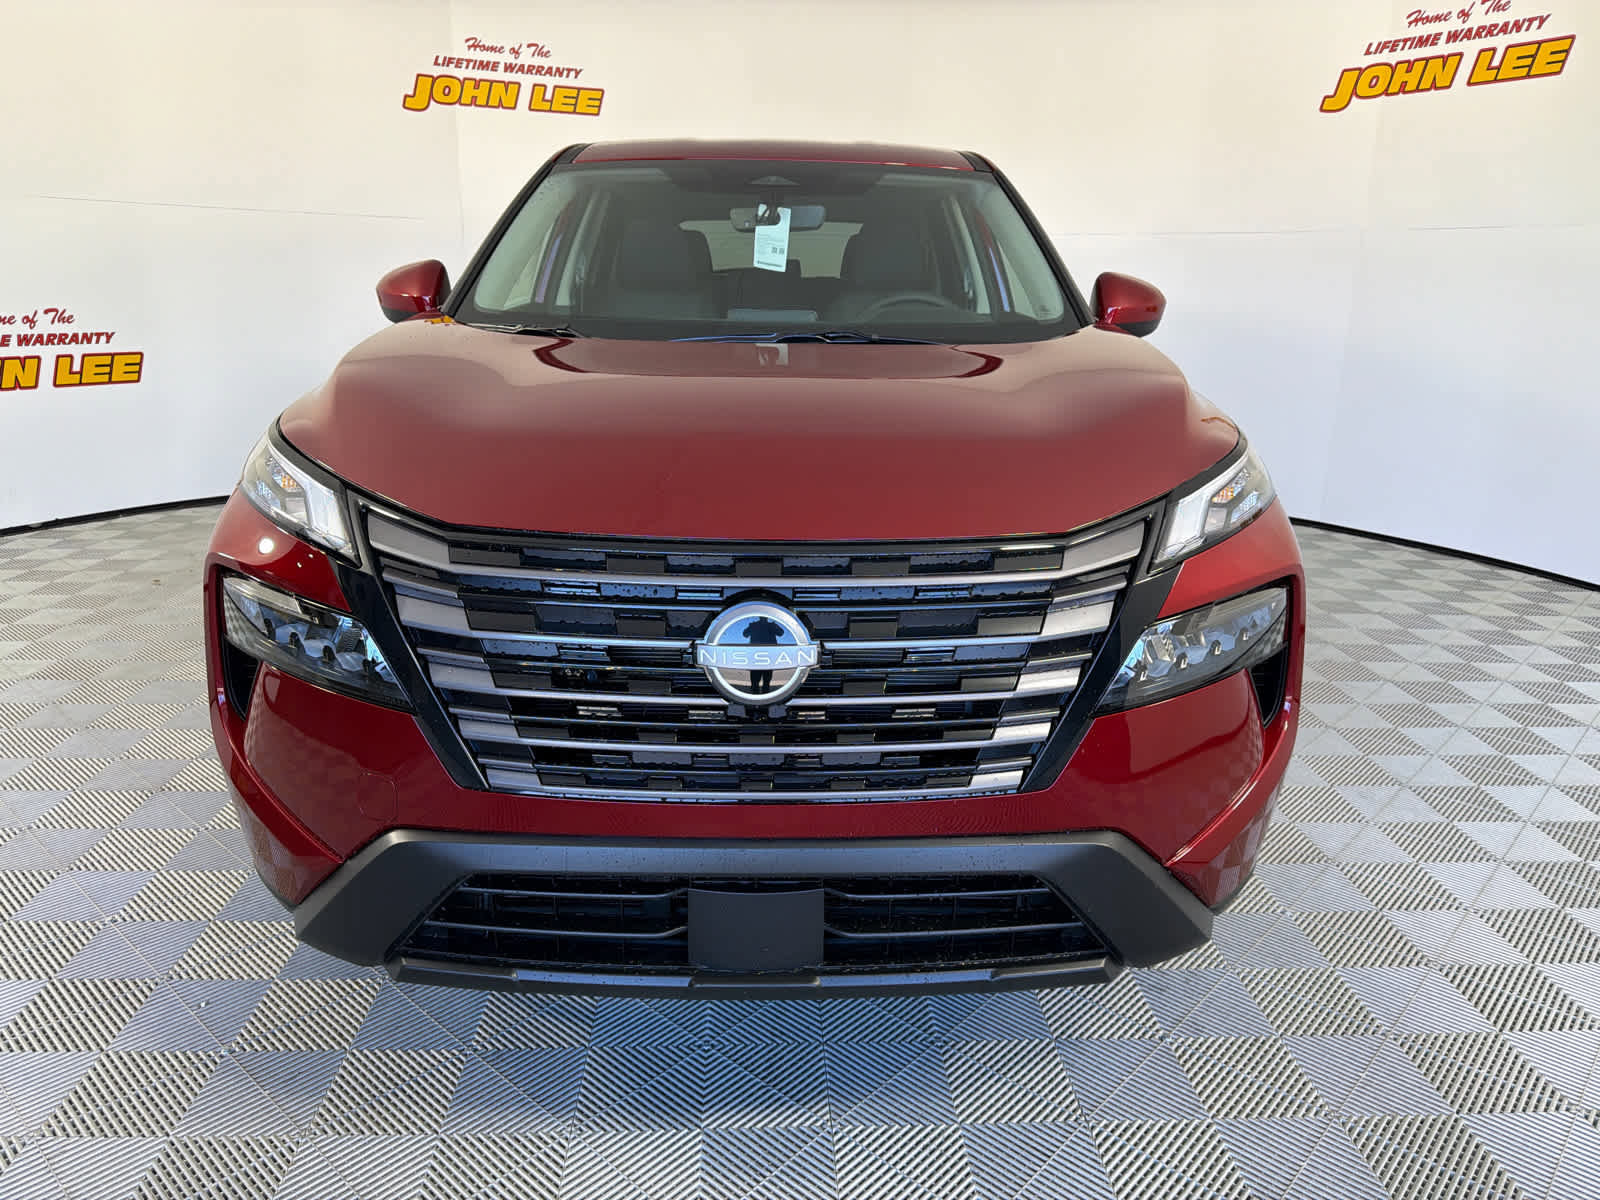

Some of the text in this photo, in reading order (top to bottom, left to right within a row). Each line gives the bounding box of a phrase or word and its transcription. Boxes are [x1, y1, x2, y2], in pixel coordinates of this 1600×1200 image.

[1405, 0, 1511, 28] Home of The
[464, 37, 552, 59] Home of The
[1363, 14, 1552, 56] LIFETIME WARRANTY
[433, 55, 583, 79] LIFETIME WARRANTY
[1320, 34, 1576, 113] JOHN LEE
[402, 73, 604, 116] JOHN LEE
[22, 310, 38, 330] of
[43, 308, 75, 325] The
[16, 331, 116, 347] WARRANTY
[0, 352, 144, 391] N LEE
[699, 648, 816, 666] NISSAN
